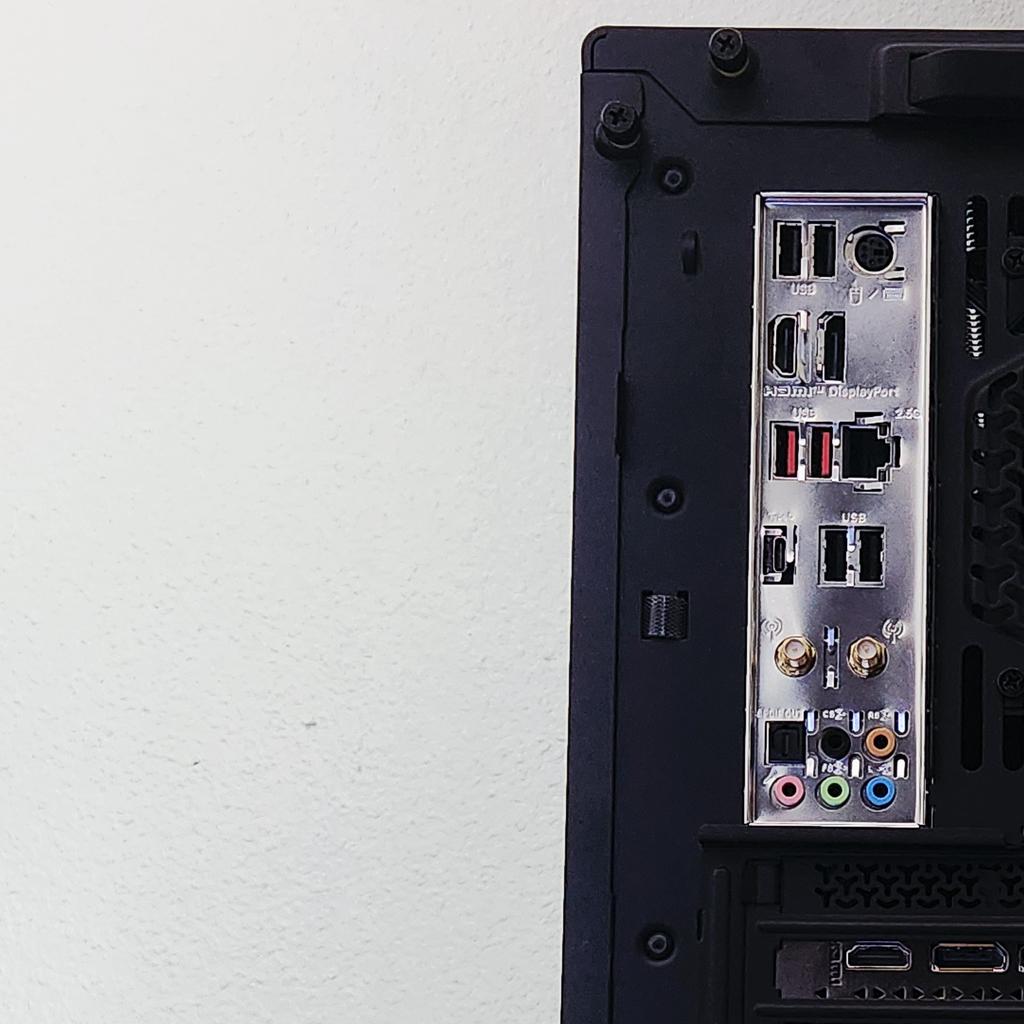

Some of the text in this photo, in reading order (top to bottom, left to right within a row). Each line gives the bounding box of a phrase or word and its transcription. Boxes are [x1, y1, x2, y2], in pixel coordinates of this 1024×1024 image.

[791, 283, 817, 295] USB
[828, 386, 900, 399] DisplayPort
[841, 512, 867, 523] USB
